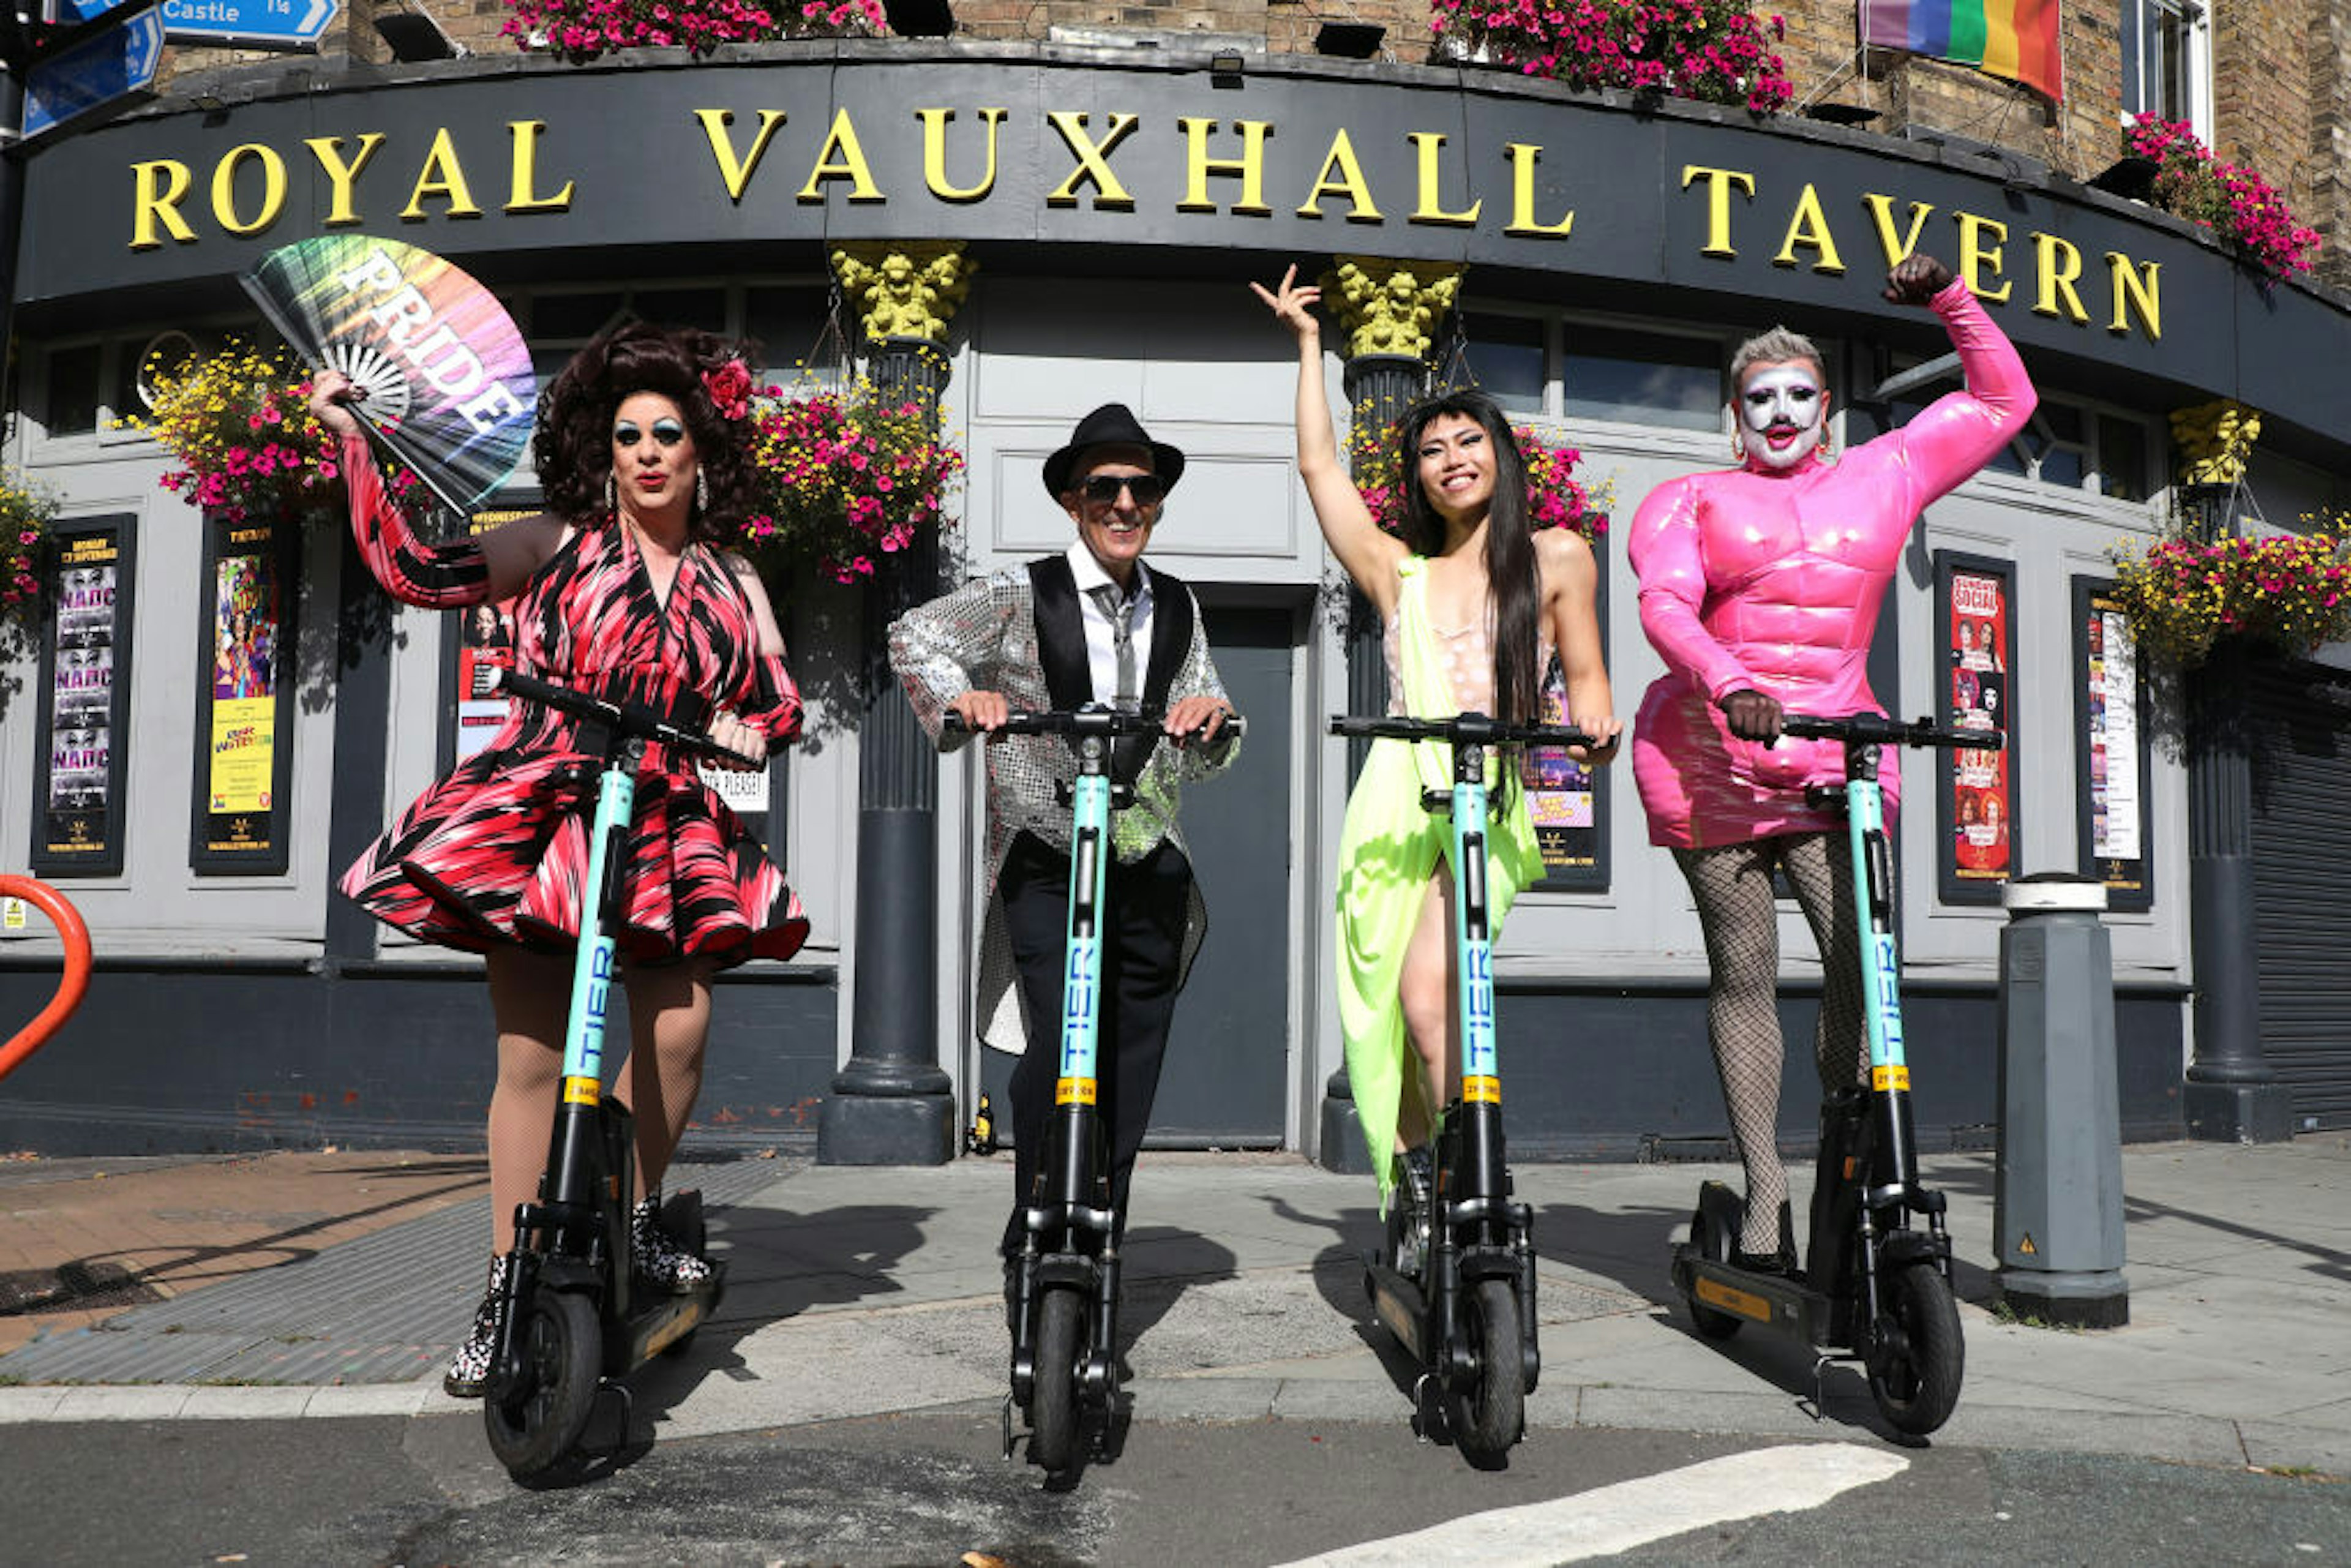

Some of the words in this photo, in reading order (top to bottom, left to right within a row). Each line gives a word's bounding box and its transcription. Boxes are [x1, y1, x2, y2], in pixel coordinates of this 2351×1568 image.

[164, 1, 239, 22] Castle
[127, 120, 575, 250] ROYAL
[692, 107, 1575, 240] VAUXHALL
[1681, 164, 2162, 342] TAVERN
[339, 248, 526, 433] PRIDE
[1955, 588, 1997, 610] SOCIAL
[580, 945, 613, 1068] TIER
[1065, 947, 1094, 1070] TIER
[1468, 947, 1493, 1068] TIER
[1875, 940, 1902, 1057] TIER
